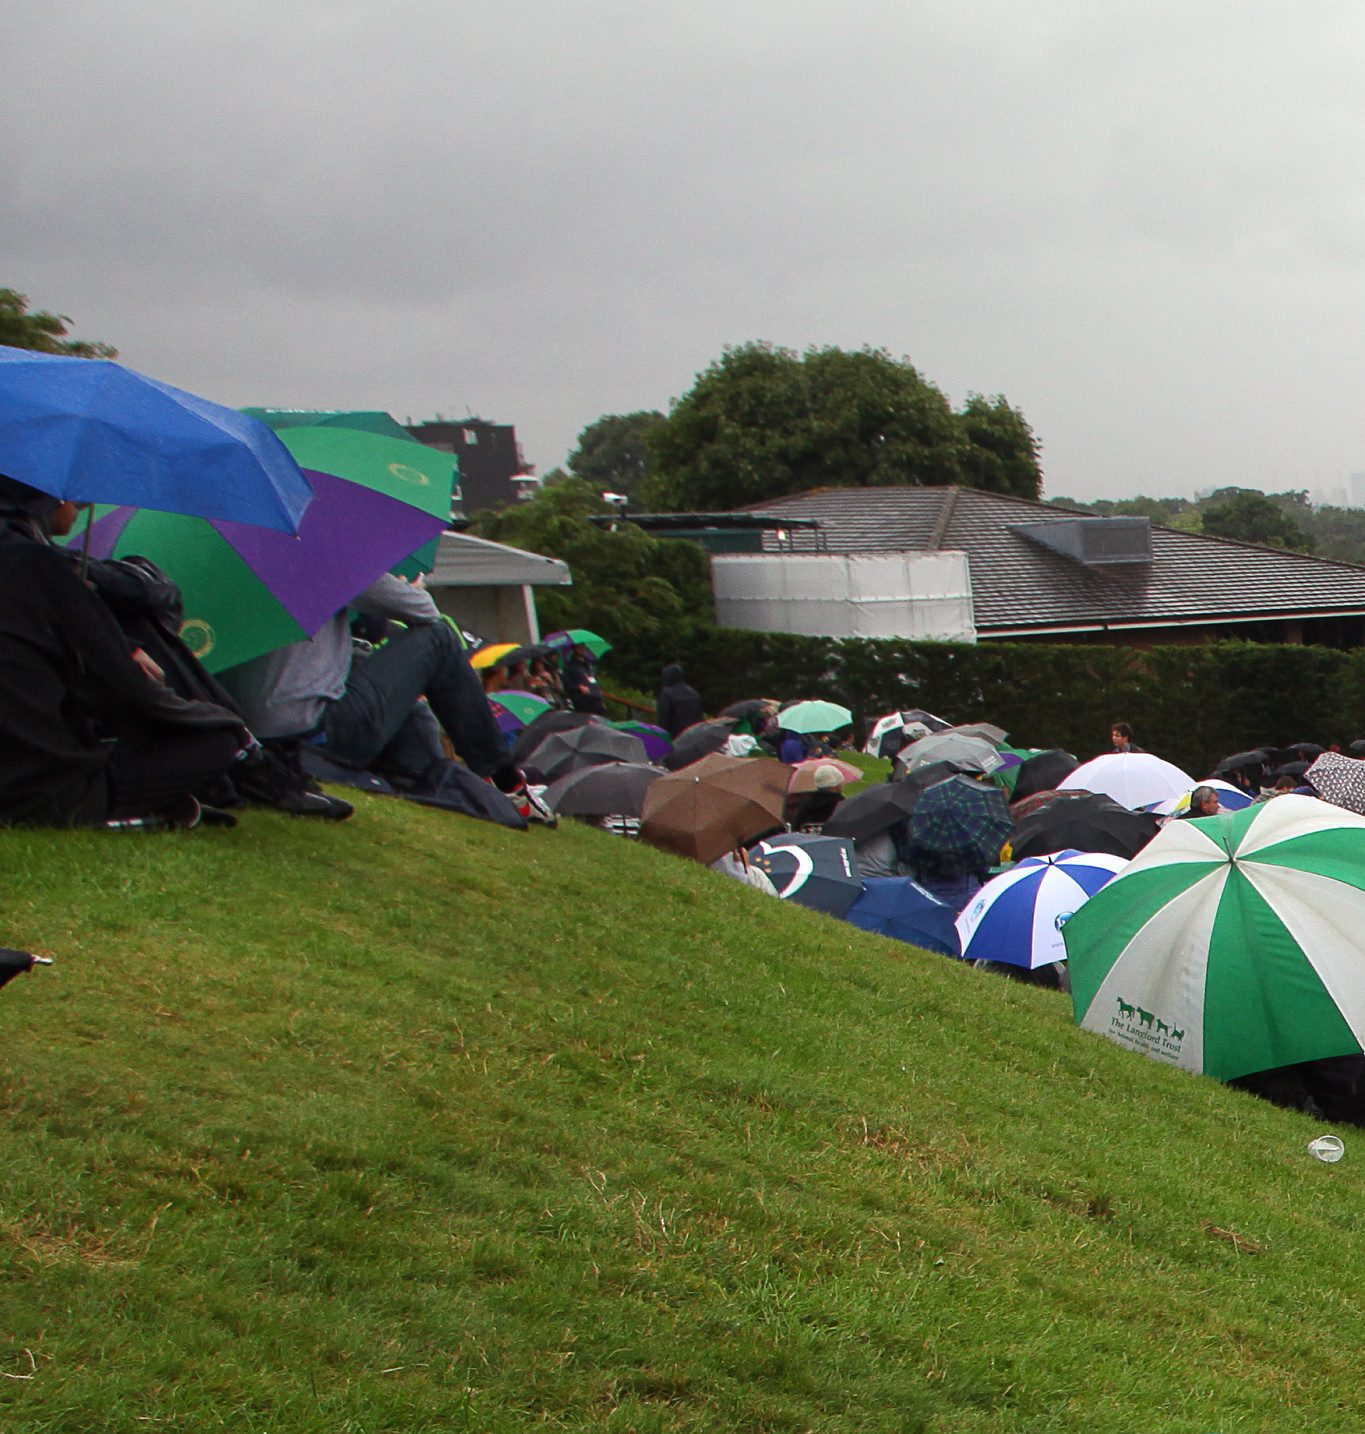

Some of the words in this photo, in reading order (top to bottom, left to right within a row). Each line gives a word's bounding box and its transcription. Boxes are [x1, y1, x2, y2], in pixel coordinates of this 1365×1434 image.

[1112, 1016, 1125, 1029] The
[1126, 1023, 1161, 1044] Langford
[1162, 1038, 1181, 1053] Trust
